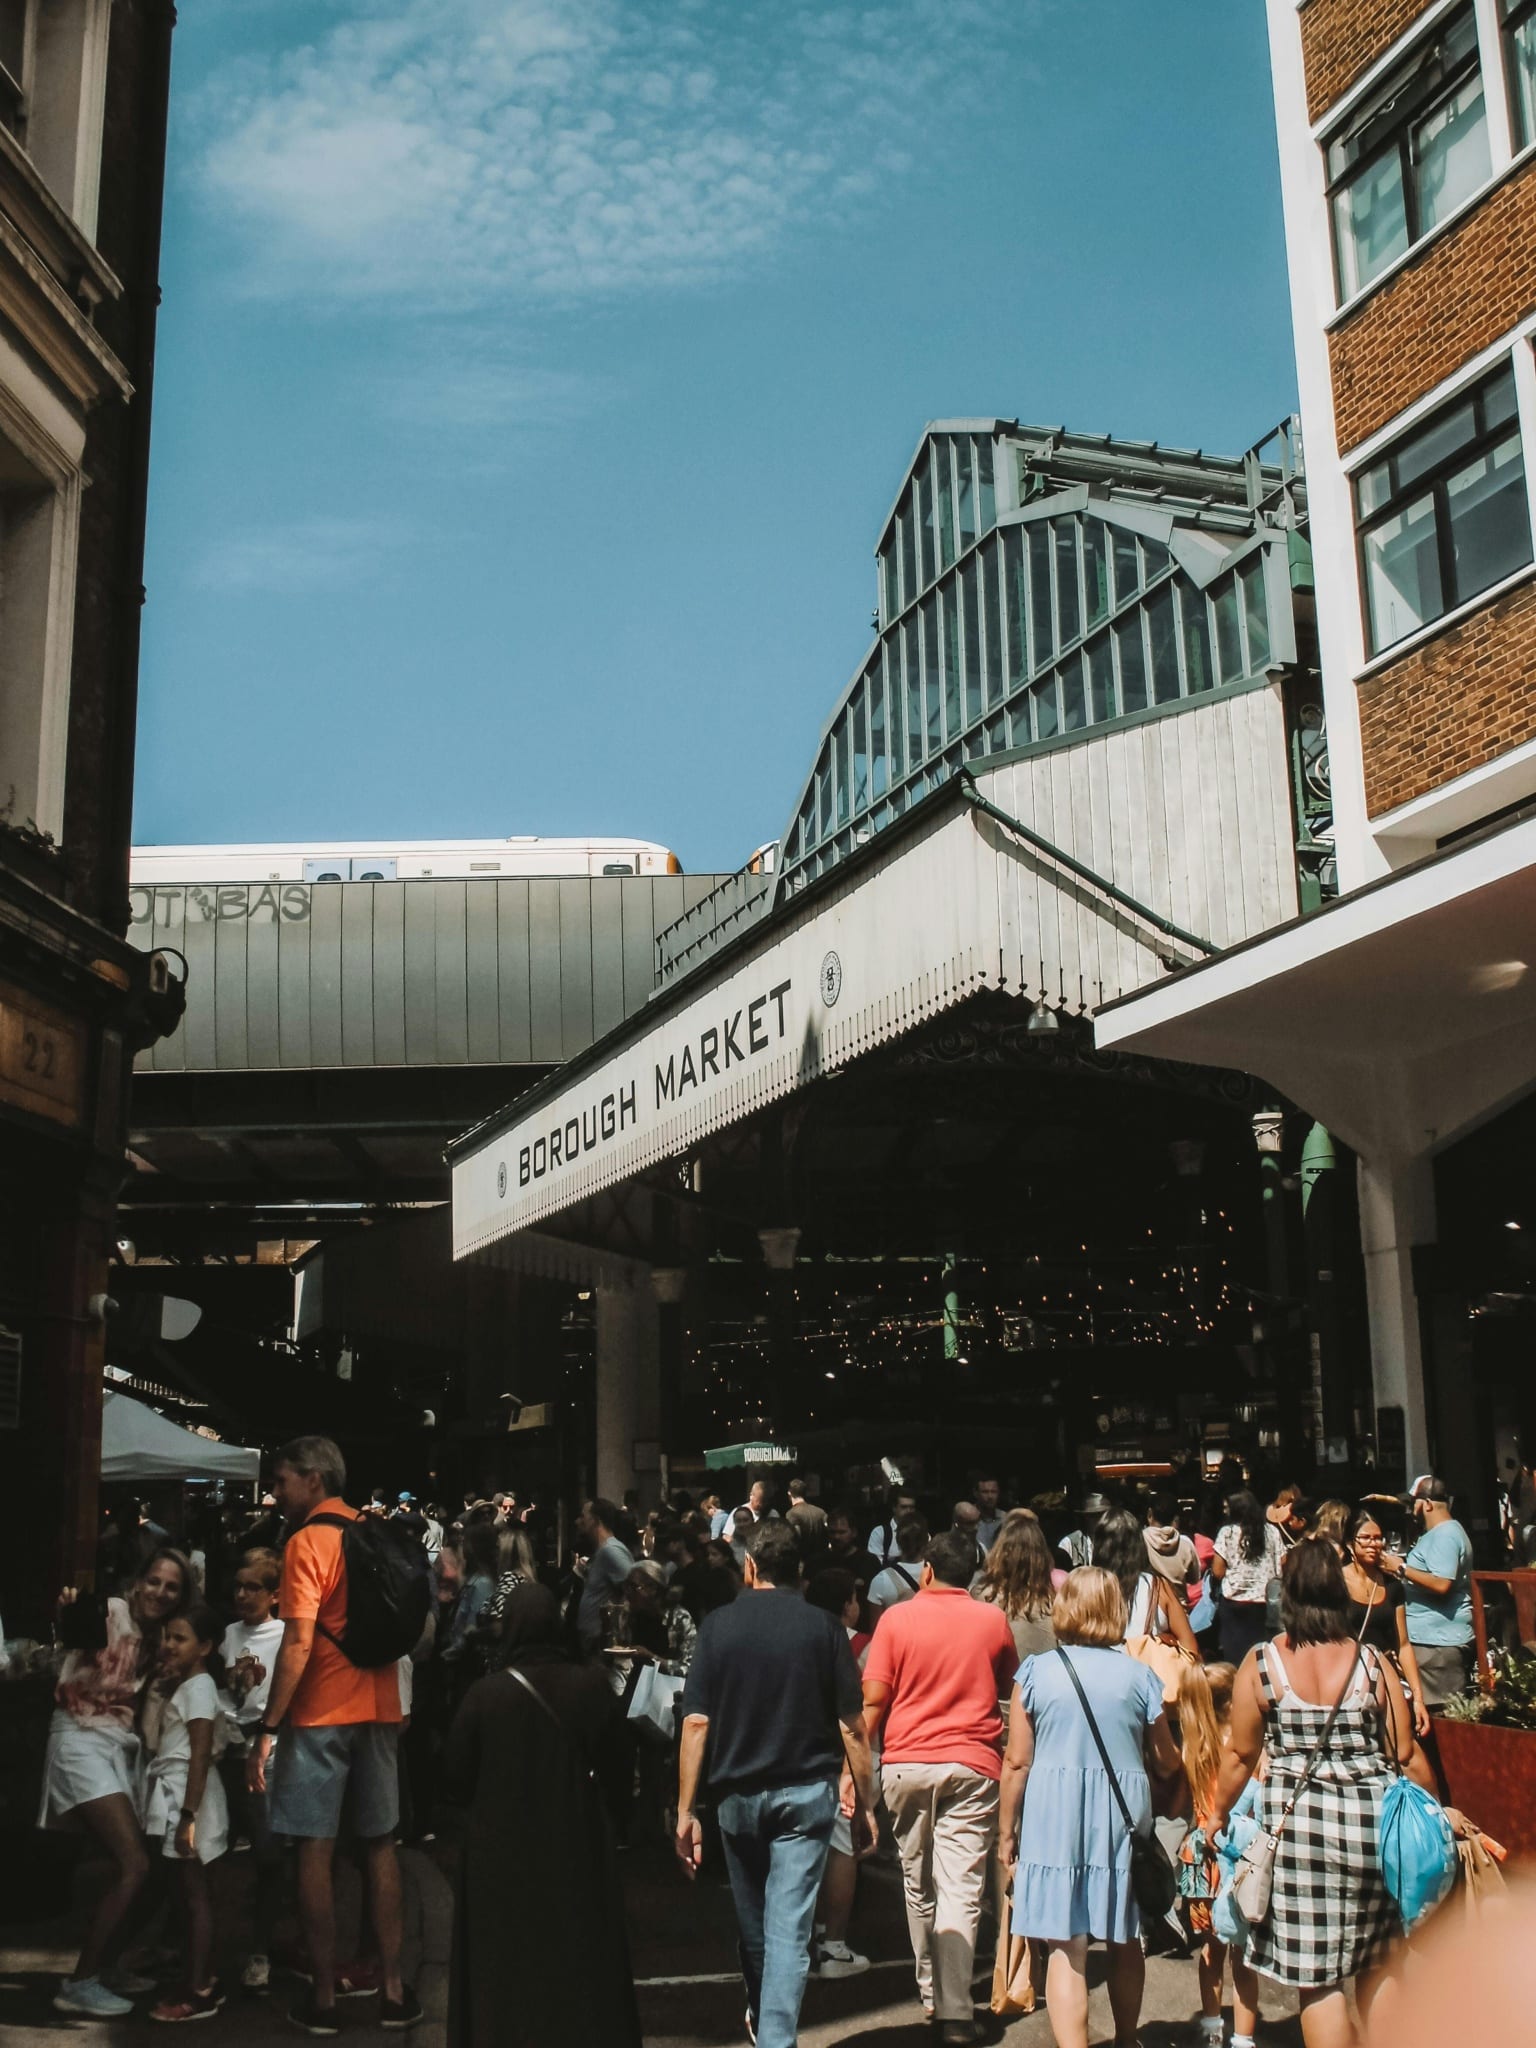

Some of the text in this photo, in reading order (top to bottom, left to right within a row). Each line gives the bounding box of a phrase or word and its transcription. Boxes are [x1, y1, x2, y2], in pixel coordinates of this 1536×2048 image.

[24, 1031, 54, 1079] 22
[520, 1080, 636, 1187] BOROUGH
[656, 979, 791, 1109] MARKET
